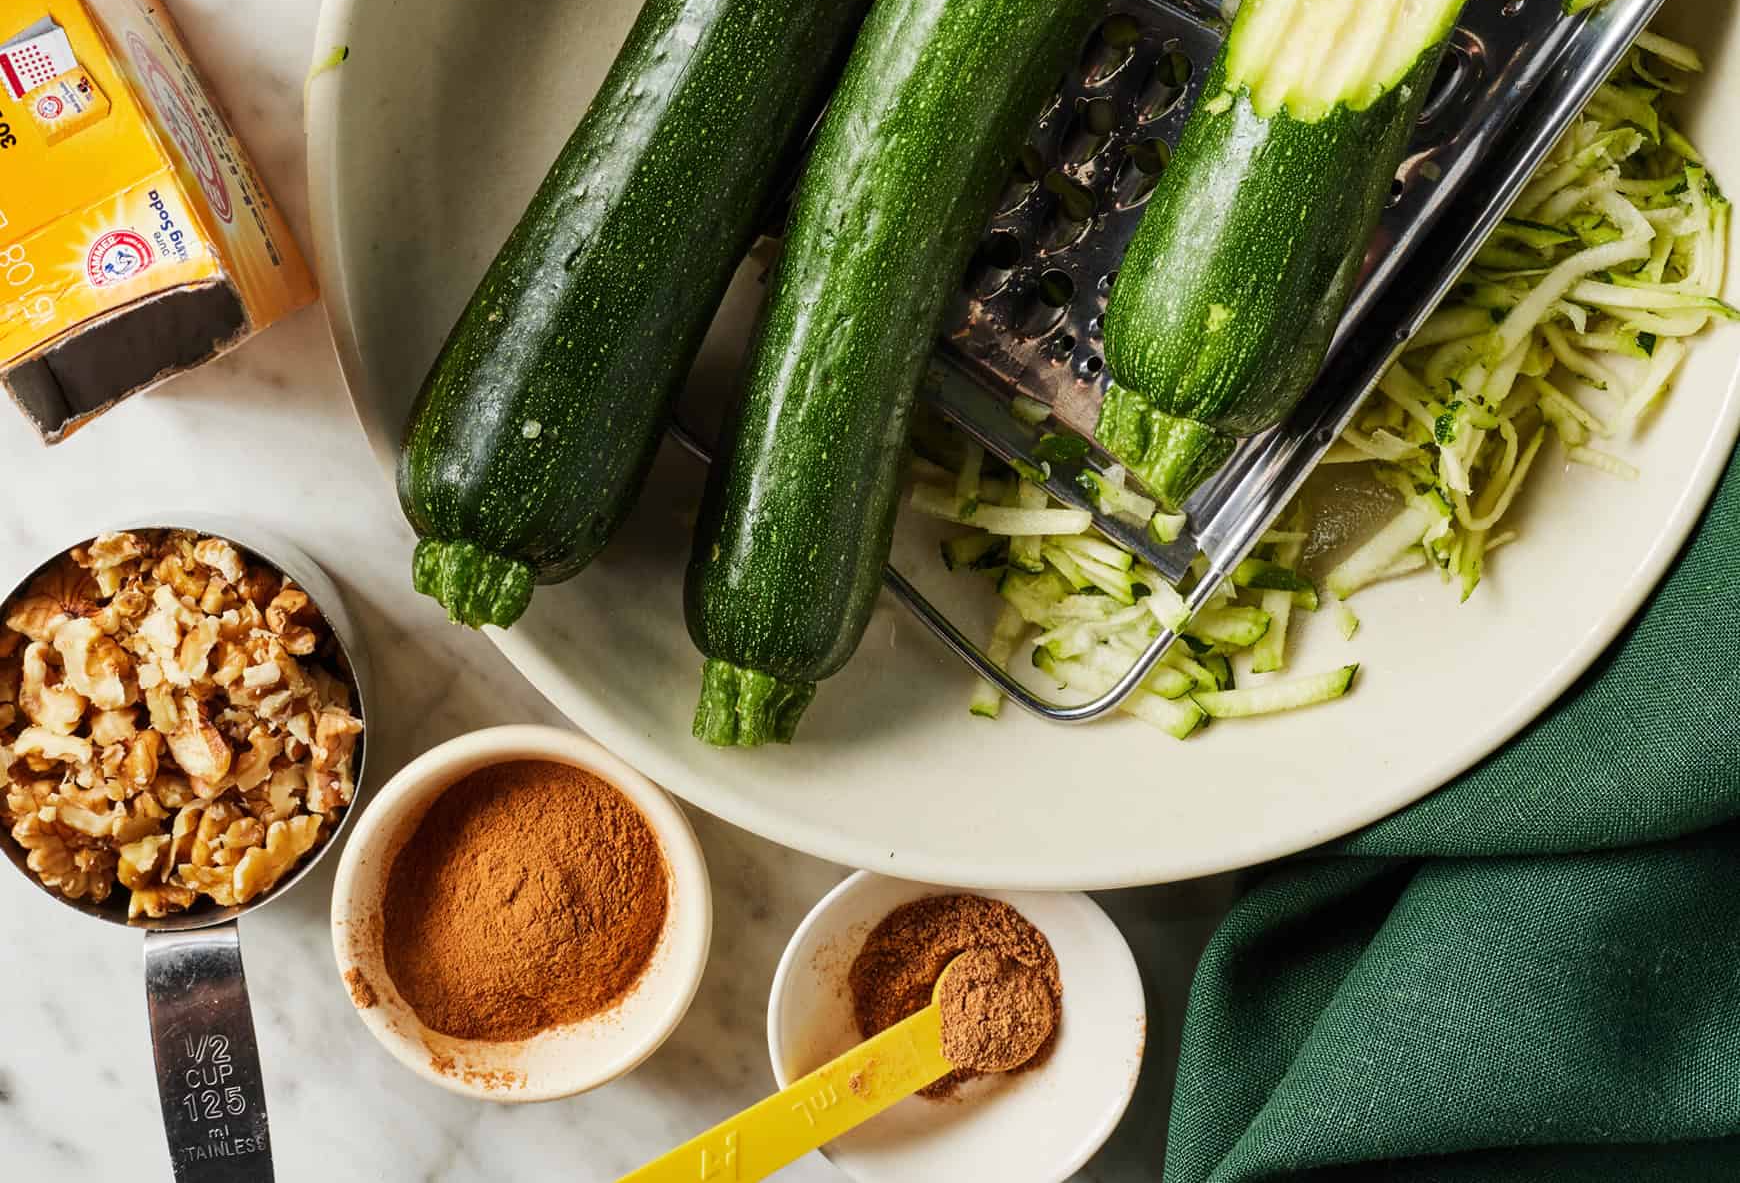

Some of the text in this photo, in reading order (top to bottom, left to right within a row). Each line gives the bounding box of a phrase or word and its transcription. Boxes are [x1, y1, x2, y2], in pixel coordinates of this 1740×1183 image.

[148, 188, 175, 232] Soda
[183, 1032, 232, 1065] 1/2
[185, 1063, 233, 1089] CUP
[182, 1085, 247, 1123] 125
